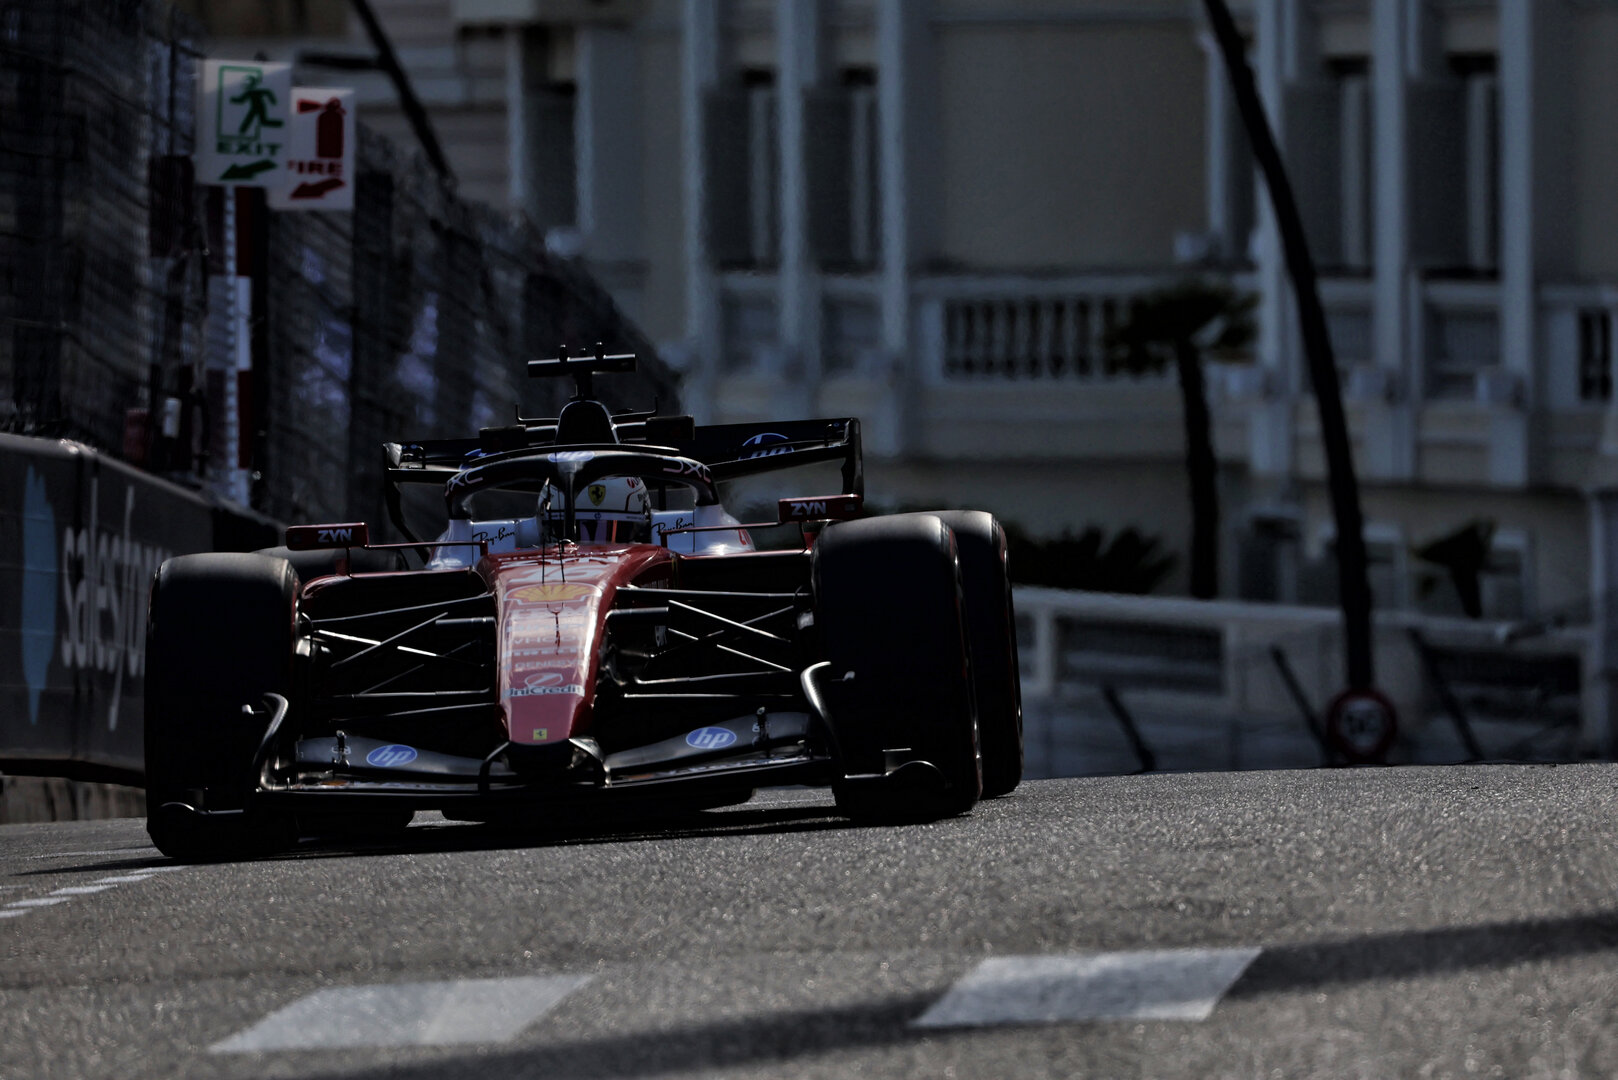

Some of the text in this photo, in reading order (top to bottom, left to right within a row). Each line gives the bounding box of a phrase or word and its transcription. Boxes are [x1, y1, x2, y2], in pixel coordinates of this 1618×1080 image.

[217, 142, 281, 155] EXIT
[287, 160, 342, 176] FIRE
[789, 501, 828, 517] ZYN
[317, 528, 353, 544] ZYN
[61, 476, 173, 733] salesfor
[692, 727, 731, 749] hp
[372, 745, 413, 767] hp
